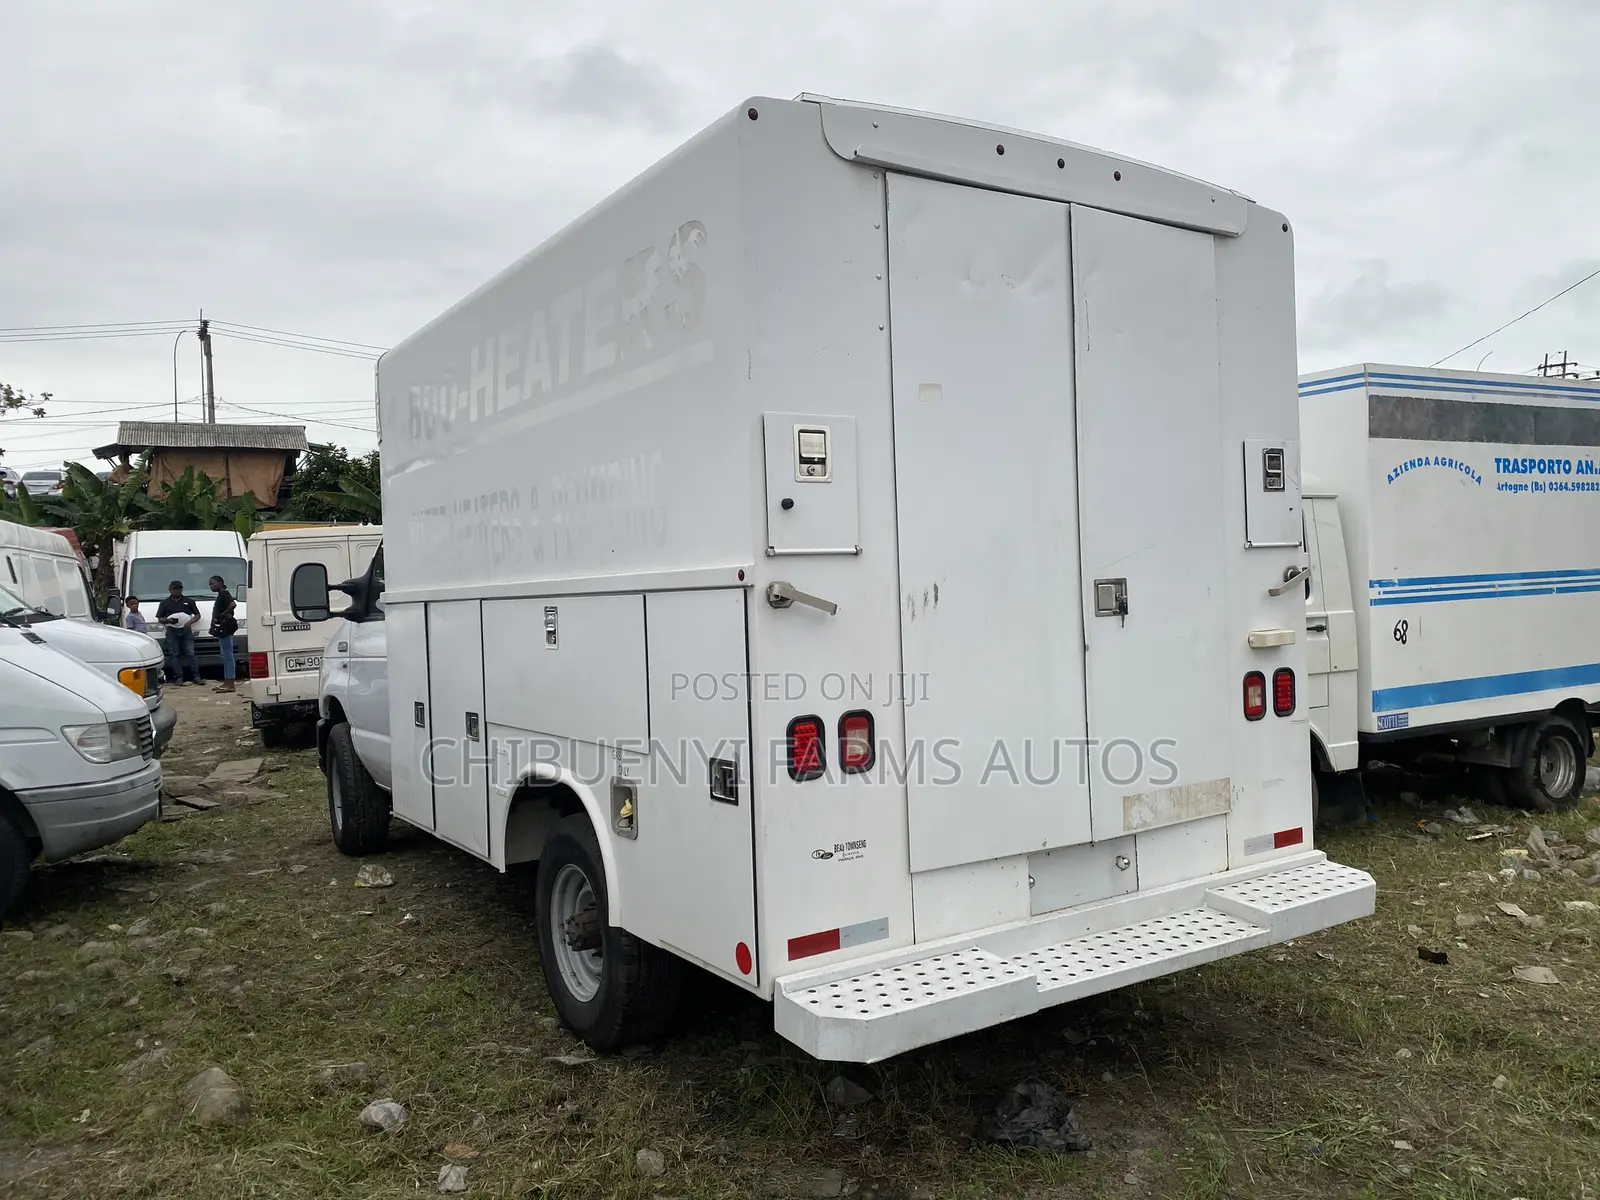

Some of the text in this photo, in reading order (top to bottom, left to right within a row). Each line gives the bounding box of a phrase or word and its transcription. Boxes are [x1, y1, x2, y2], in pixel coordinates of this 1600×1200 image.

[1386, 456, 1482, 486] AZIENDA AGRICOLA
[1494, 457, 1600, 475] TRASPORTO AN
[1531, 480, 1546, 493] (Bs)
[1393, 619, 1408, 645] 68
[1377, 714, 1398, 731] SCOTTI
